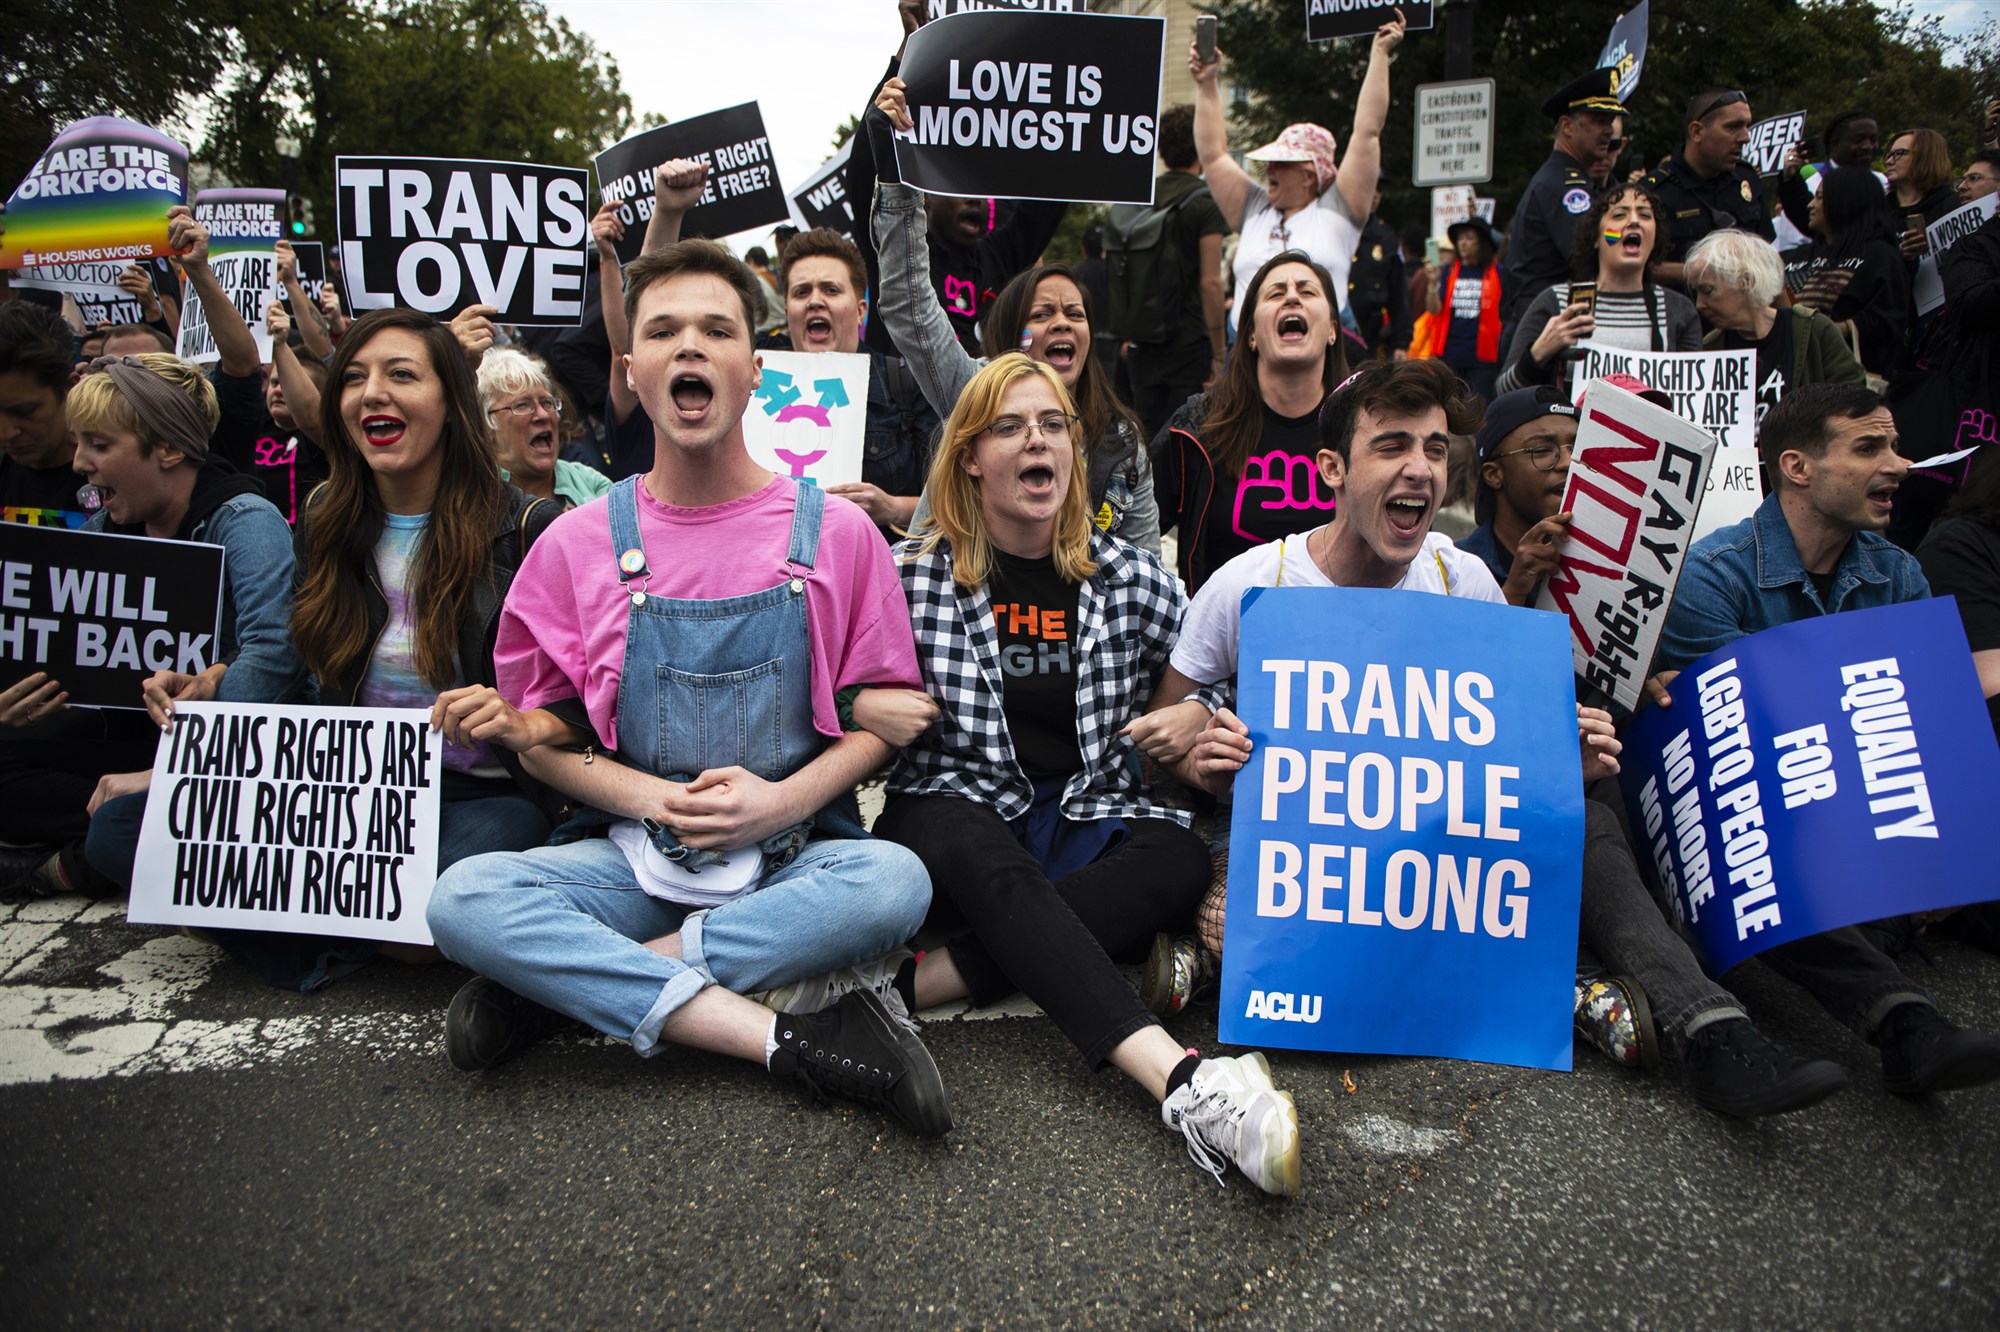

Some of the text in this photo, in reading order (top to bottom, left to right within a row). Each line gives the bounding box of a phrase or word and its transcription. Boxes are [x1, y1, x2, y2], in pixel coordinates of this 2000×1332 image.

[949, 60, 1102, 106] LOVE IS
[895, 105, 1154, 155] AMONGST US
[1748, 116, 1803, 151] UEER
[17, 167, 181, 200] ORKFORCE
[47, 145, 107, 174] ARE
[110, 145, 170, 172] THE
[602, 175, 636, 204] WHO
[714, 137, 769, 170] RIGHT
[719, 165, 770, 199] FREE?
[195, 204, 275, 220] WE ARE THE
[340, 168, 586, 247] TRANS
[807, 176, 846, 212] WE
[198, 221, 281, 237] ORKFORCE
[1935, 207, 1985, 247] WORKER
[38, 244, 153, 264] HOUSING WORKS
[240, 258, 272, 289] ARE
[343, 240, 583, 316] LOVE
[232, 290, 262, 321] ARE
[1582, 351, 1749, 391] TRANS RIGHTS ARE
[1702, 392, 1739, 425] ARE
[1723, 465, 1754, 491] ARE
[1548, 408, 1660, 657] NOW
[1640, 441, 1702, 575] GAY
[0, 559, 168, 623] E WILL
[992, 603, 1067, 640] THE
[75, 622, 212, 676] BACK
[1262, 660, 1495, 746] TRANS
[167, 713, 432, 788] TRANS RIGHTS ARE
[1662, 728, 1695, 795] NO
[1773, 723, 1837, 810] FOR
[1840, 657, 1939, 840] EQUALITY
[168, 777, 416, 855] CIVIL RIGHTS ARE
[1261, 747, 1520, 842] PEOPLE
[1639, 774, 1662, 840] NO
[1696, 657, 1781, 941] LGBTQ PEOPLE
[173, 842, 404, 922] HUMAN RIGHTS
[1257, 840, 1531, 939] BELONG
[1245, 990, 1322, 1024] ACLU
